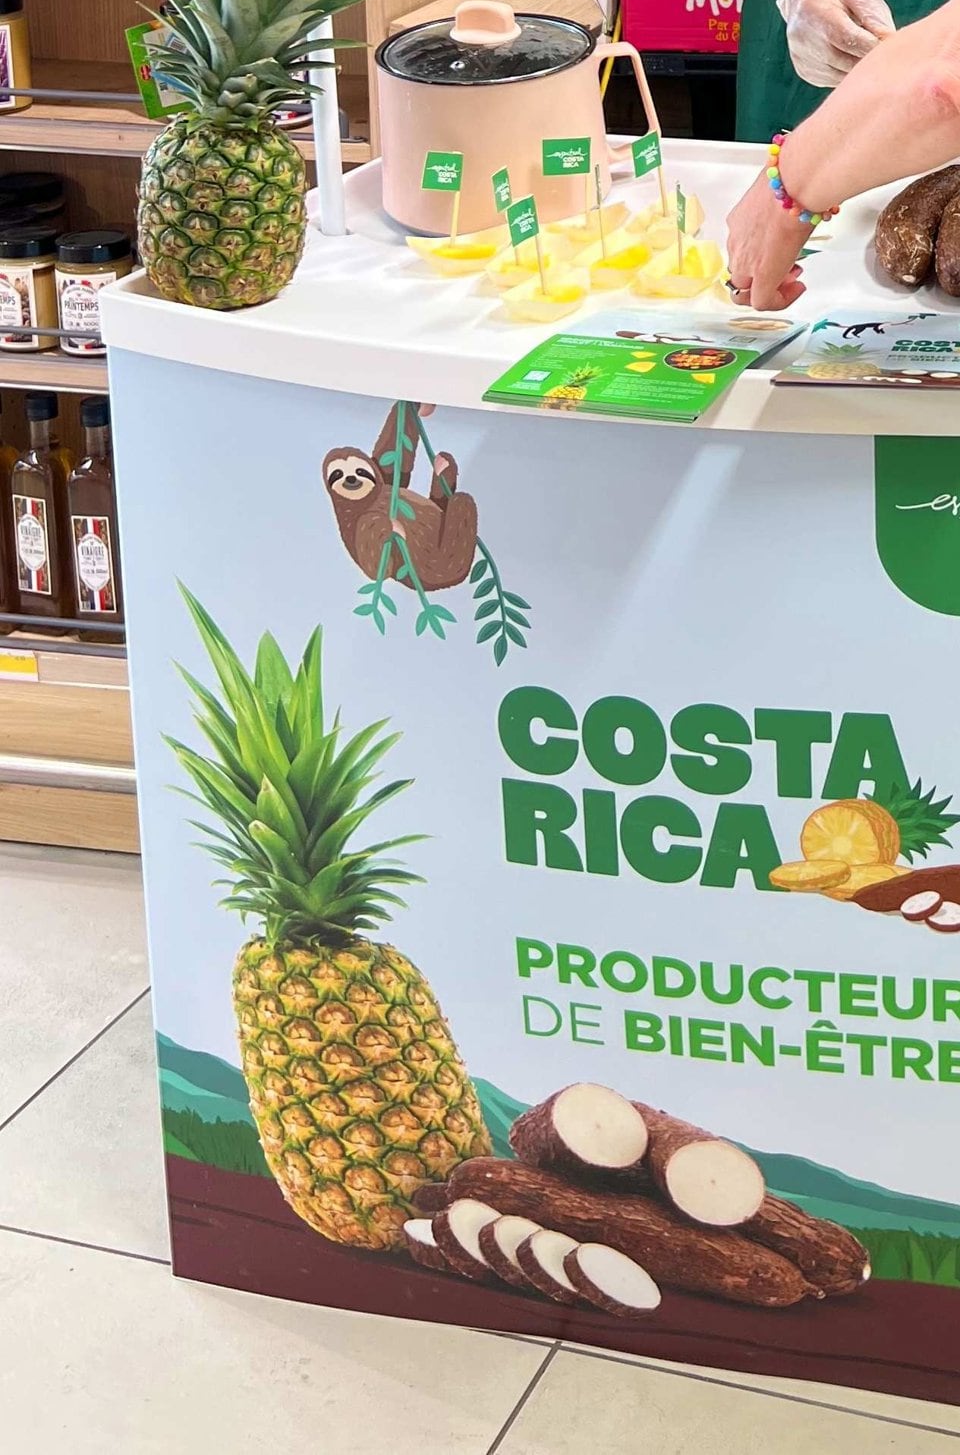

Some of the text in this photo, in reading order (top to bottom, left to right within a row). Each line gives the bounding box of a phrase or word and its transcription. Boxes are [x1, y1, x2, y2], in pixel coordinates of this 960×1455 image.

[498, 685, 914, 801] COSTA
[501, 777, 789, 892] RICA
[522, 994, 605, 1046] DE
